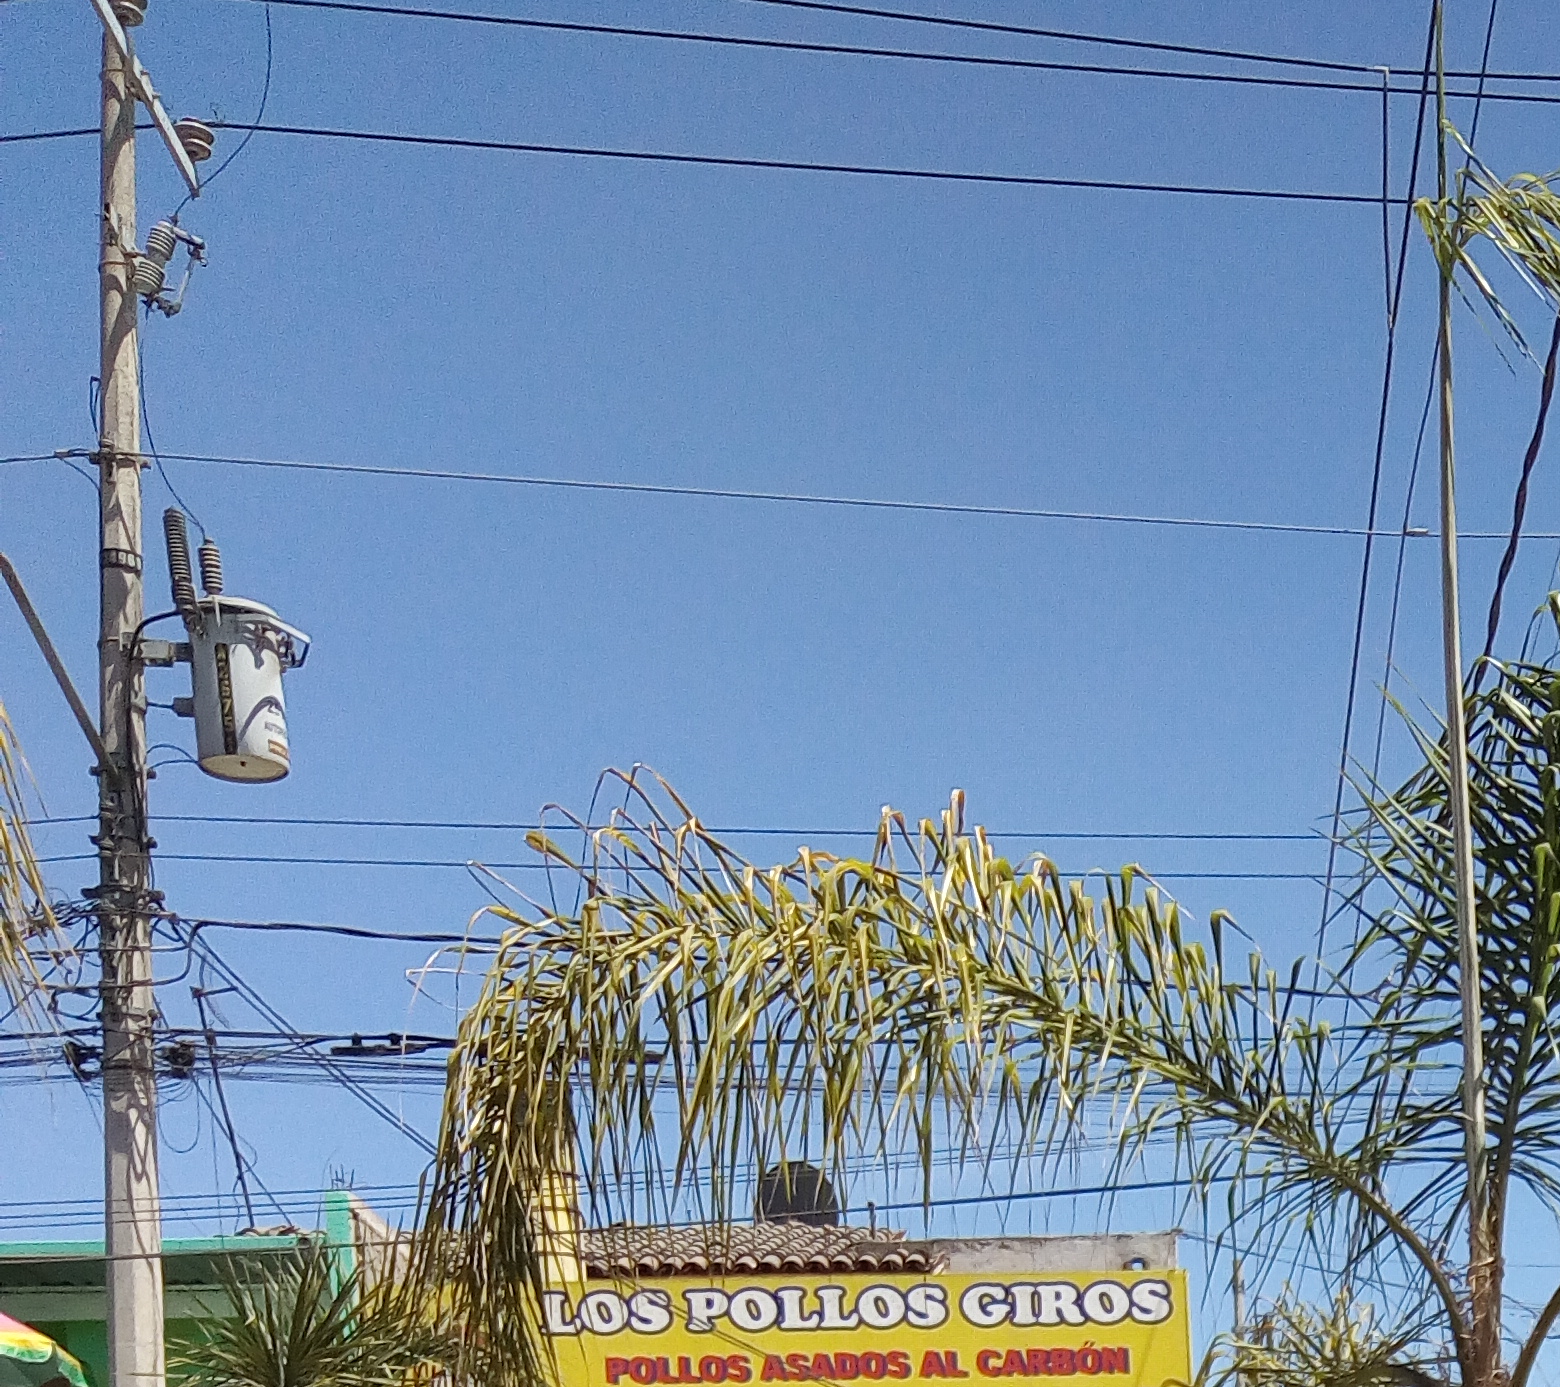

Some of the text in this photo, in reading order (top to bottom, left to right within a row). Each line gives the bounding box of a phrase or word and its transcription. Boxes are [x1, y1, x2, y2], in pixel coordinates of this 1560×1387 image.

[541, 1279, 1173, 1335] LOS POLLOS GIROS
[605, 1341, 1131, 1385] POLLOS ASADOS AL CARBÓN
